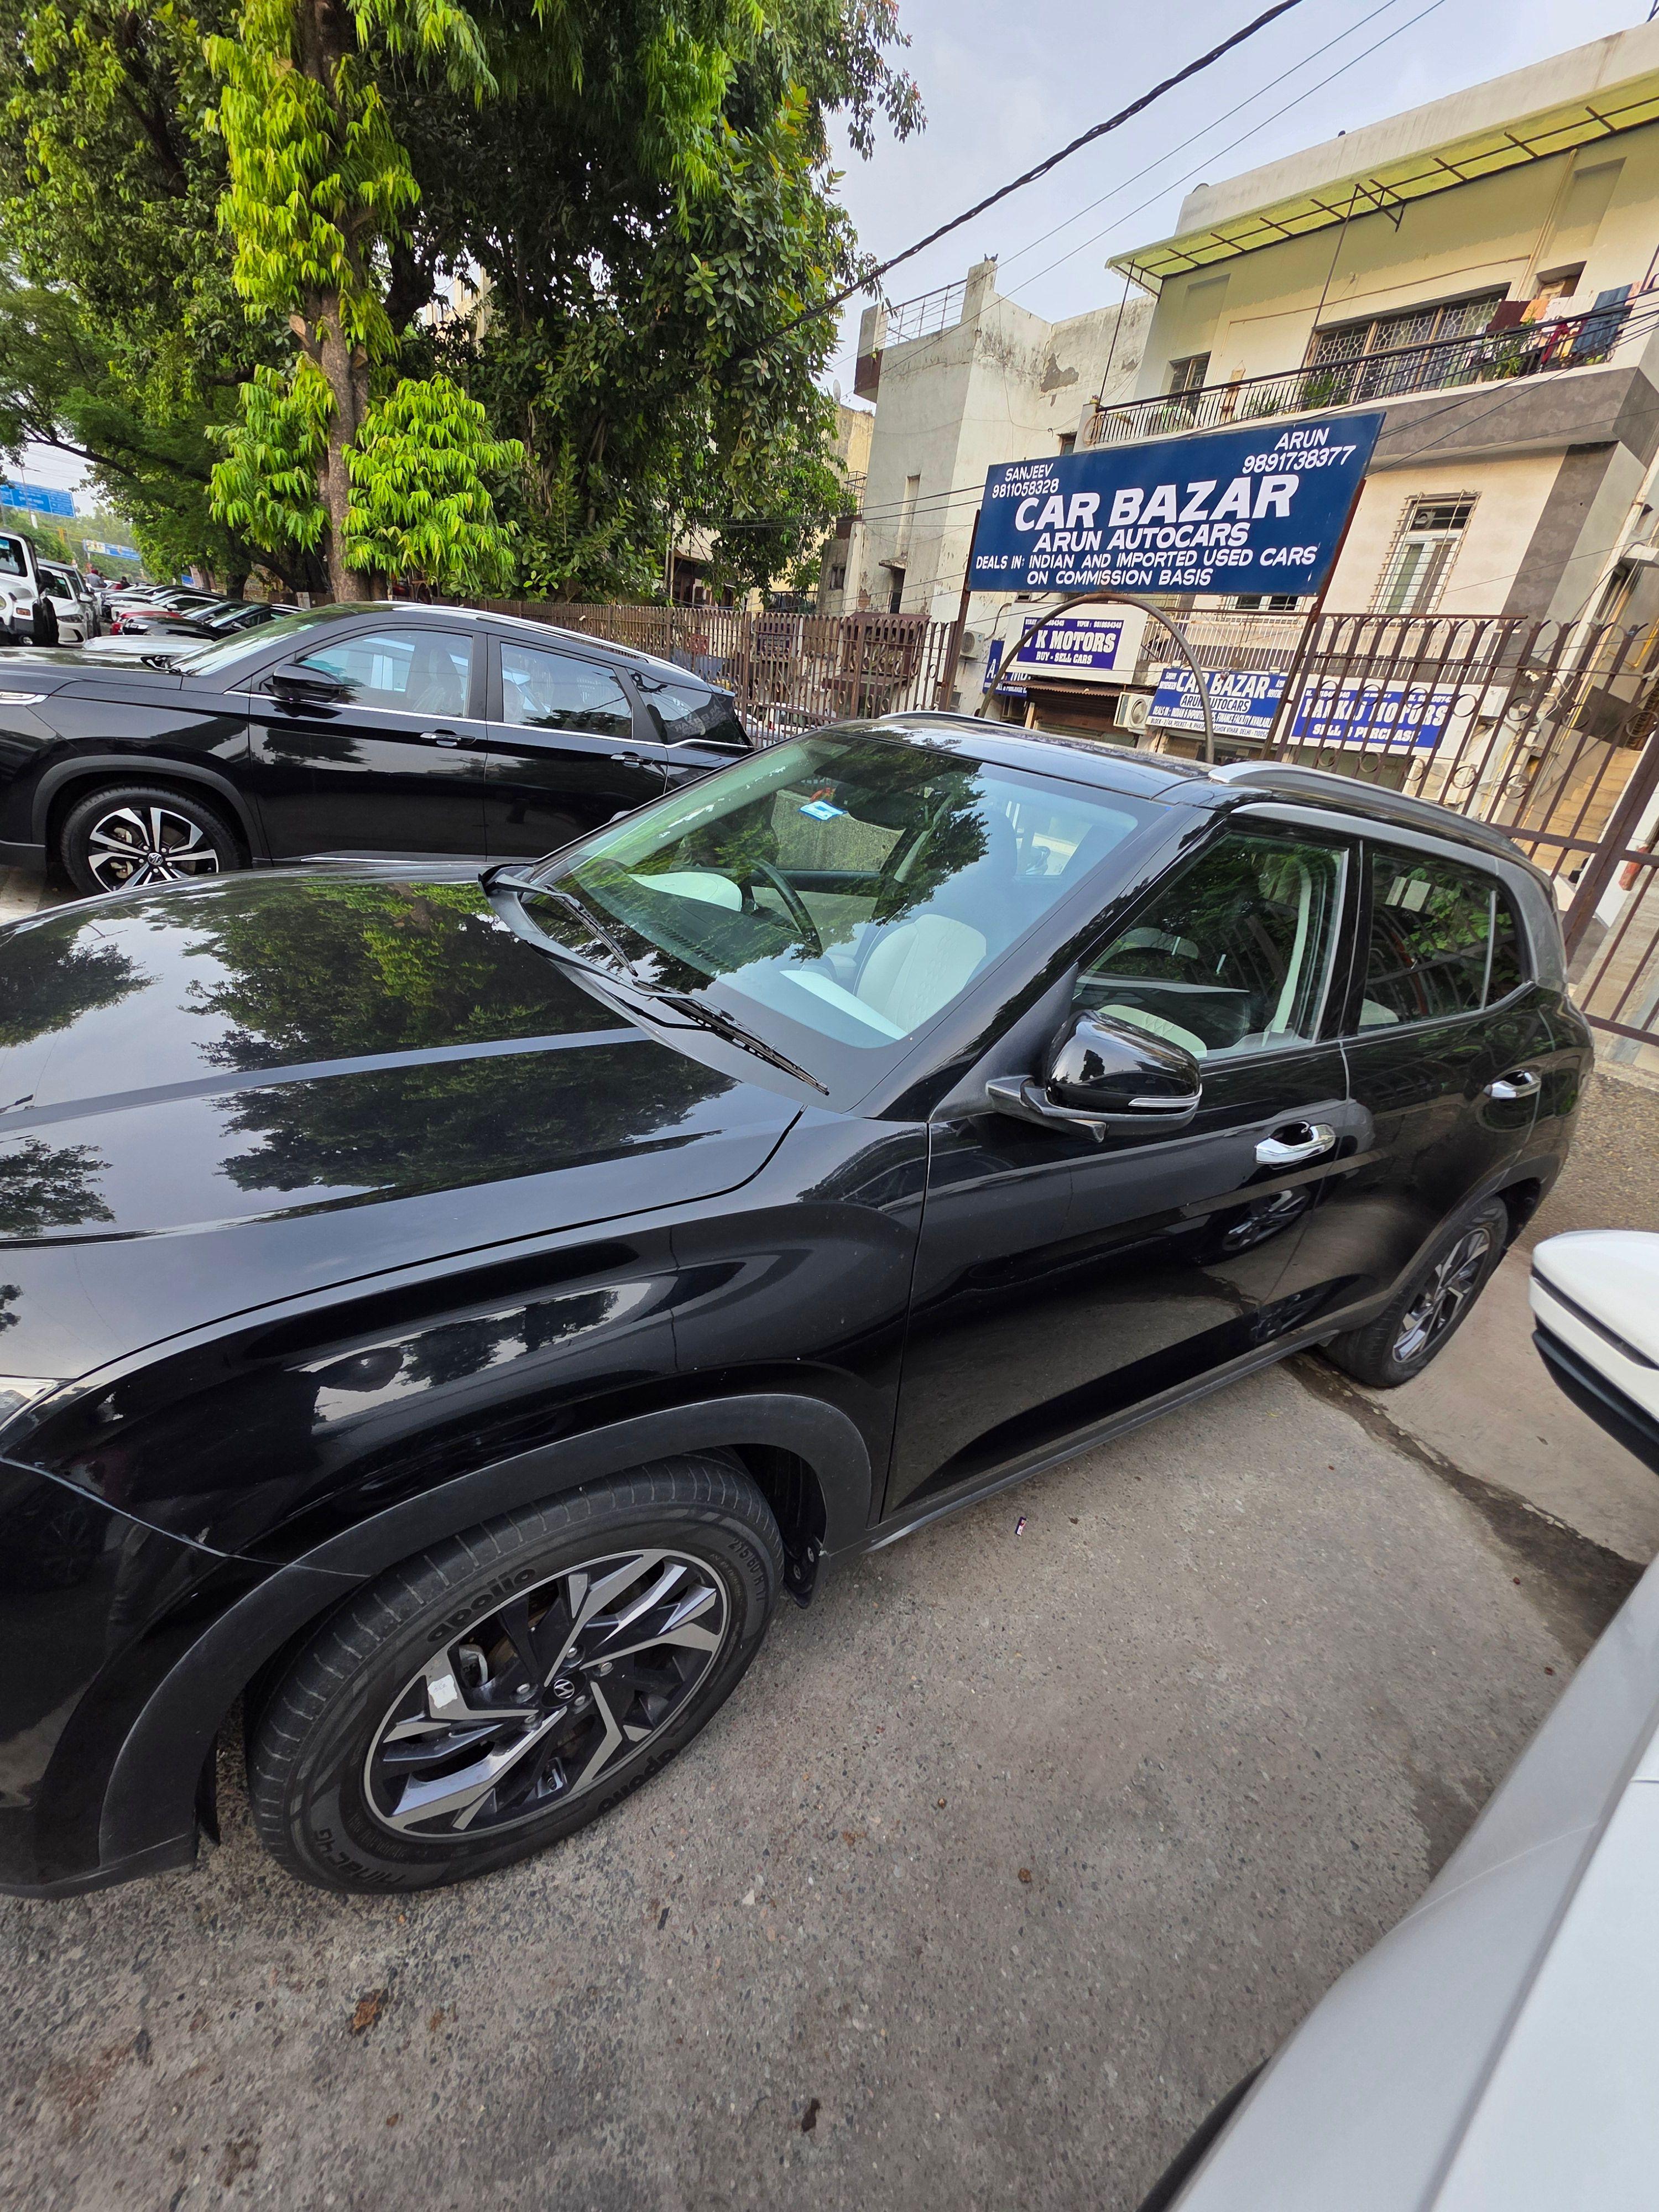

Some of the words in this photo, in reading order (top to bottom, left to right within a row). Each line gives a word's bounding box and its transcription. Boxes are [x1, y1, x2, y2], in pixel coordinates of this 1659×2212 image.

[1274, 427, 1330, 451] ARUN
[1242, 445, 1357, 474] 9891738377
[1005, 462, 1053, 482] SANJEEV
[992, 478, 1060, 498] 9811058328
[1015, 492, 1100, 531] CAR
[1108, 474, 1299, 528] BAZAR
[1032, 530, 1102, 552] ARUN
[1107, 522, 1250, 550] AUTOCARS
[975, 555, 1008, 569] DEALS
[1029, 554, 1075, 569] INDIAN
[1081, 553, 1111, 569] AND
[1116, 550, 1198, 568] IMPORTED
[1203, 548, 1253, 567] USED
[1260, 546, 1318, 566] CARS
[1027, 570, 1049, 585] ON
[1056, 570, 1152, 585] COMMISSION
[1159, 568, 1214, 586] BASIS
[1049, 630, 1117, 653] MOTORS
[1036, 651, 1050, 661] BUY
[1054, 652, 1072, 663] SELL
[1073, 654, 1093, 664] CARS
[1209, 673, 1270, 699] BAZAR
[1209, 697, 1249, 712] UTOCARS
[427, 1568, 535, 1642] apollo
